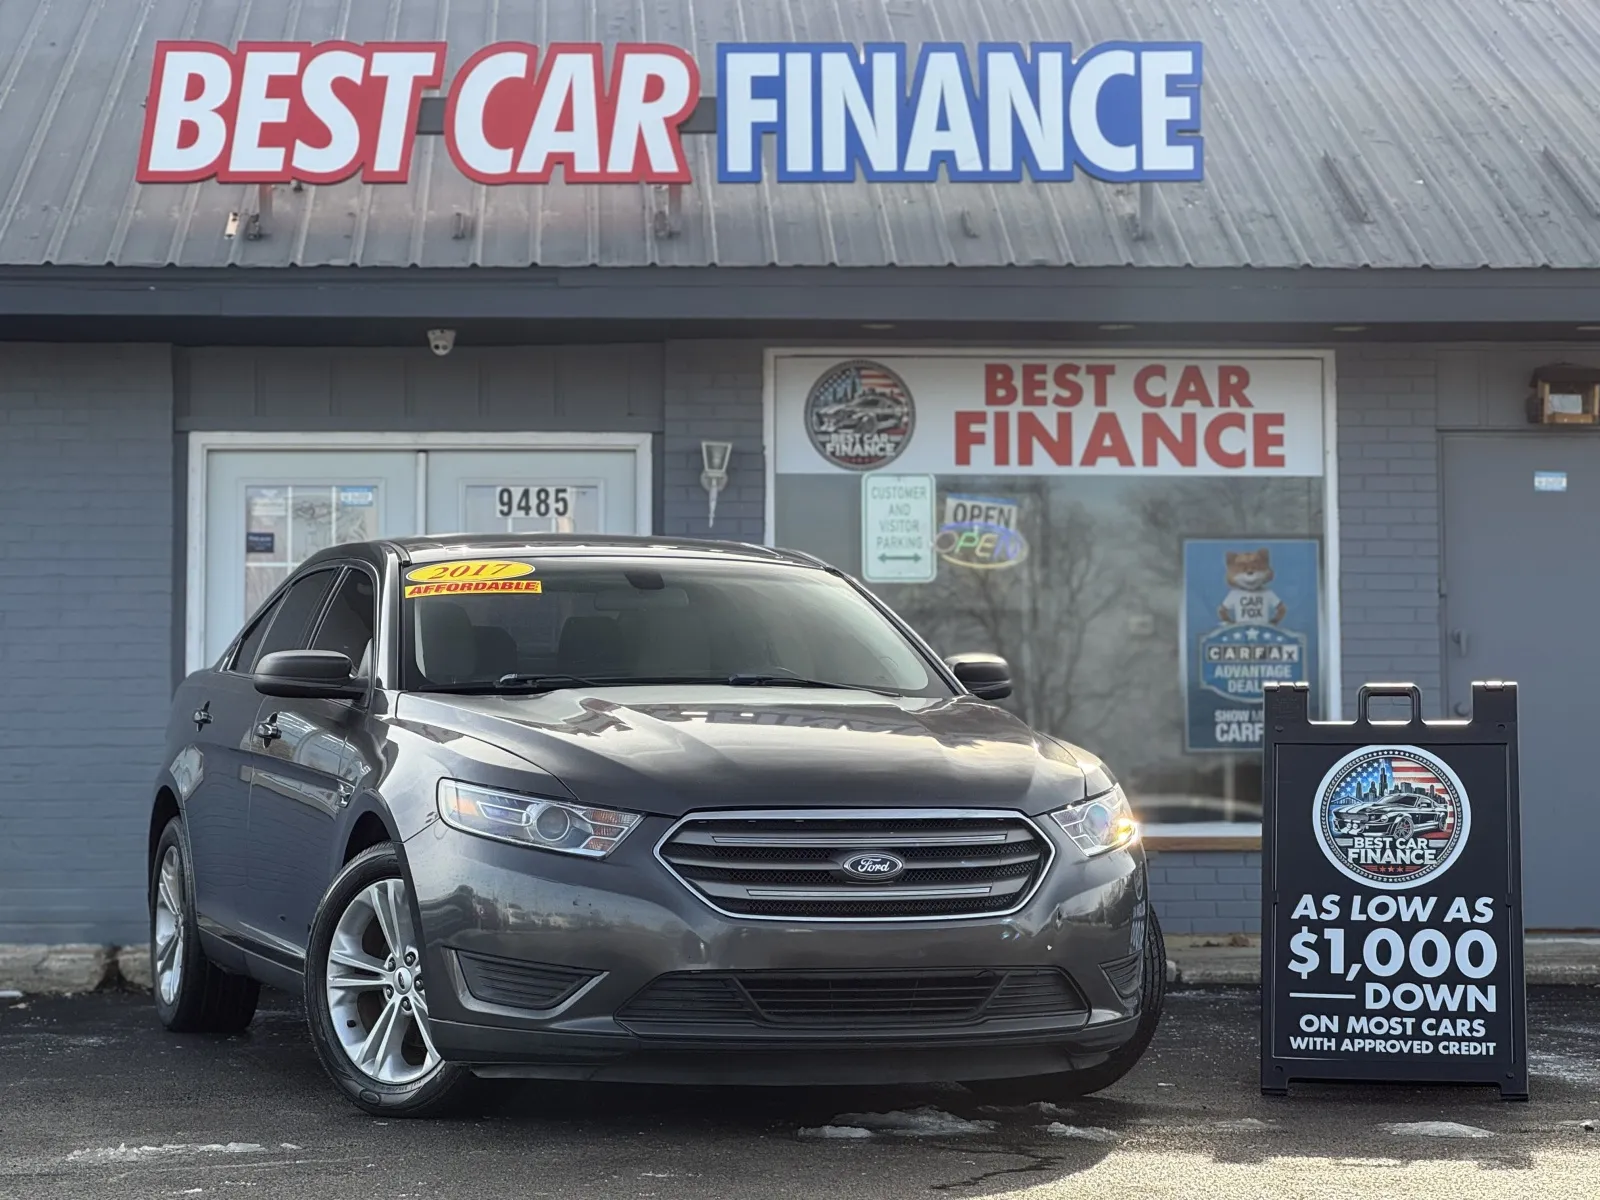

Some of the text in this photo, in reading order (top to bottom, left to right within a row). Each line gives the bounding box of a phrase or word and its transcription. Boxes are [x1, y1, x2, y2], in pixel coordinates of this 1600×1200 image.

[146, 47, 1196, 176] BEST CAR FINANCE
[984, 362, 1255, 409] BEST CAR
[830, 433, 889, 444] BEST CAR
[954, 410, 1286, 469] FINANCE
[825, 442, 897, 457] FINANCE
[871, 486, 927, 500] CUSTOMER
[498, 487, 568, 517] 9485
[888, 503, 911, 517] AND
[952, 502, 1012, 530] OPEN
[878, 519, 920, 534] VISITOR
[876, 536, 923, 550] PARKING
[934, 531, 1021, 561] OPEN
[428, 563, 512, 580] 2017
[407, 581, 539, 596] AFFORDABLE
[1239, 596, 1264, 608] CAR
[1240, 608, 1263, 619] FOX
[1208, 646, 1297, 661] CARFAX
[1214, 664, 1293, 679] ADVANTAGE
[1227, 679, 1264, 693] DEAL
[1214, 709, 1264, 723] SHOW M
[1215, 722, 1264, 743] CARF
[1353, 836, 1429, 850] BEST CAR
[1347, 848, 1438, 865] FINANCE
[857, 858, 890, 872] Ford
[1290, 893, 1494, 924] AS LOW AS
[1287, 925, 1498, 982] $1,000
[1364, 982, 1497, 1013] DOWN
[1299, 1014, 1486, 1038] ON MOST CARS
[1289, 1036, 1497, 1056] WITH APPROVED CREDIT
